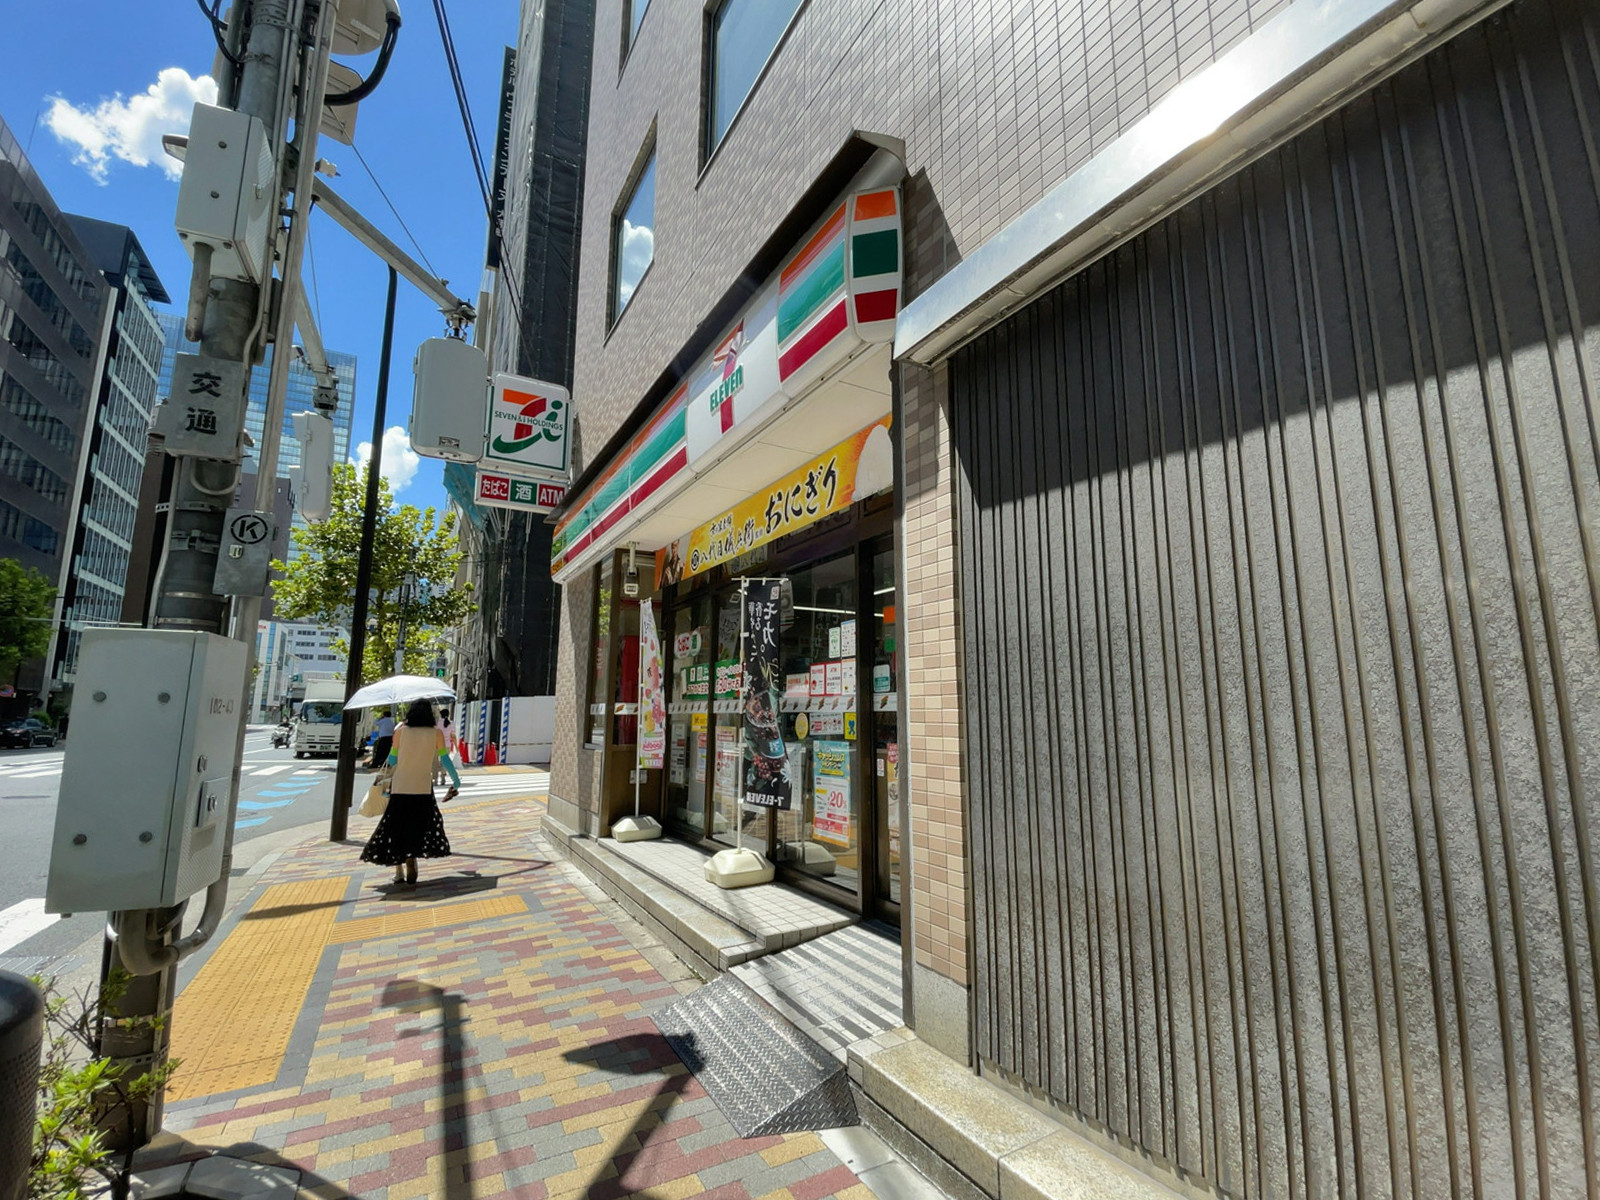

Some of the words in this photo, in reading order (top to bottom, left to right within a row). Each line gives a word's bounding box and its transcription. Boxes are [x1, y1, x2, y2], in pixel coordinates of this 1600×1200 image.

[185, 371, 222, 436] 交通
[526, 417, 564, 431] HOLDINGS
[481, 479, 508, 498] たばこ
[515, 483, 532, 501] 酒
[539, 486, 564, 508] ATM
[764, 455, 838, 535] おにぎり
